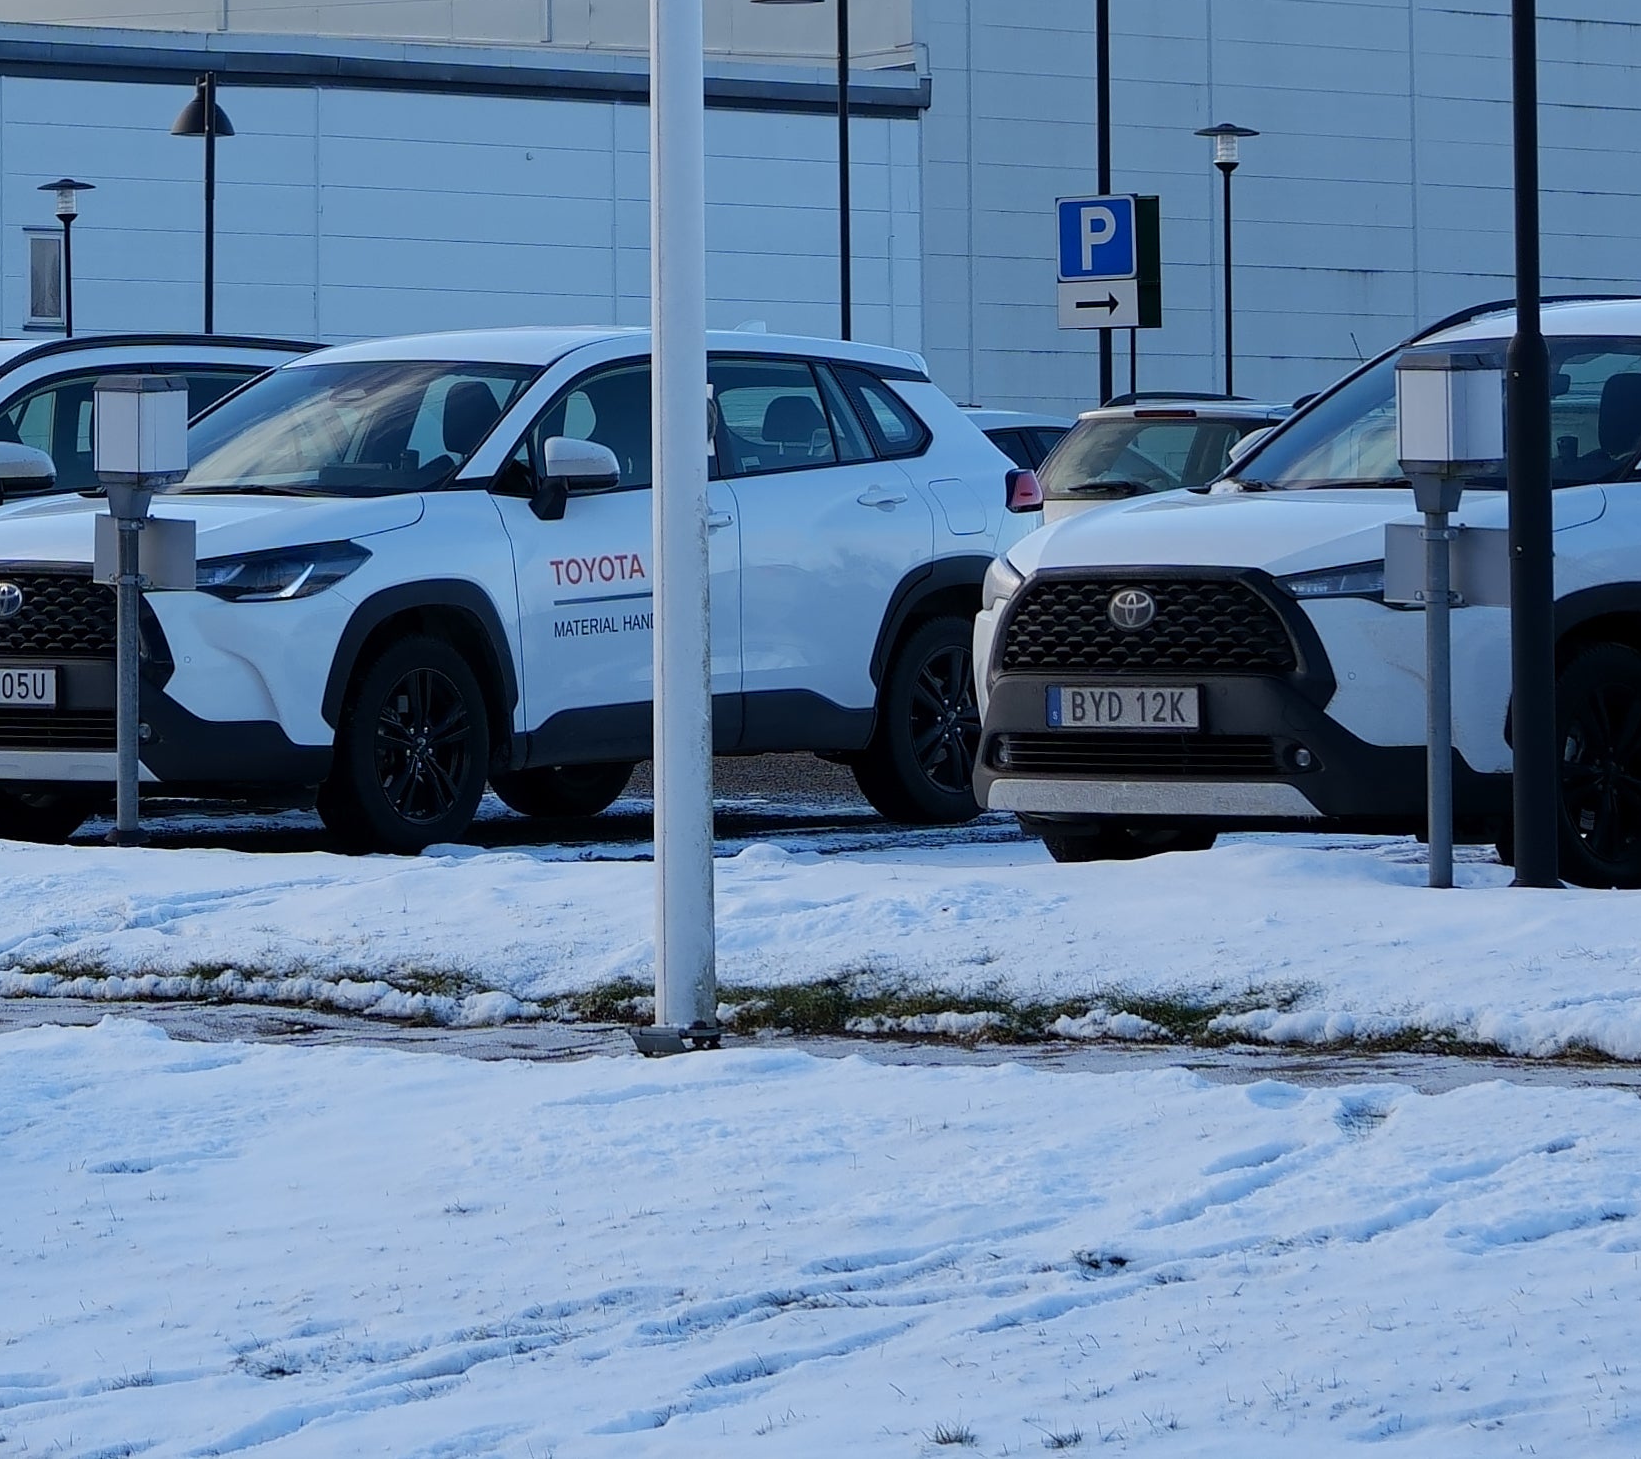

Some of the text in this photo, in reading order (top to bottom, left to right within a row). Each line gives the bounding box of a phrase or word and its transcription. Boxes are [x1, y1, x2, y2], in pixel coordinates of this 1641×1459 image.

[1080, 206, 1117, 271] P
[549, 554, 645, 586] TOYOTA
[554, 616, 619, 638] MATERIAL
[1, 672, 46, 700] 05U
[1071, 691, 1186, 722] BYD 12K
